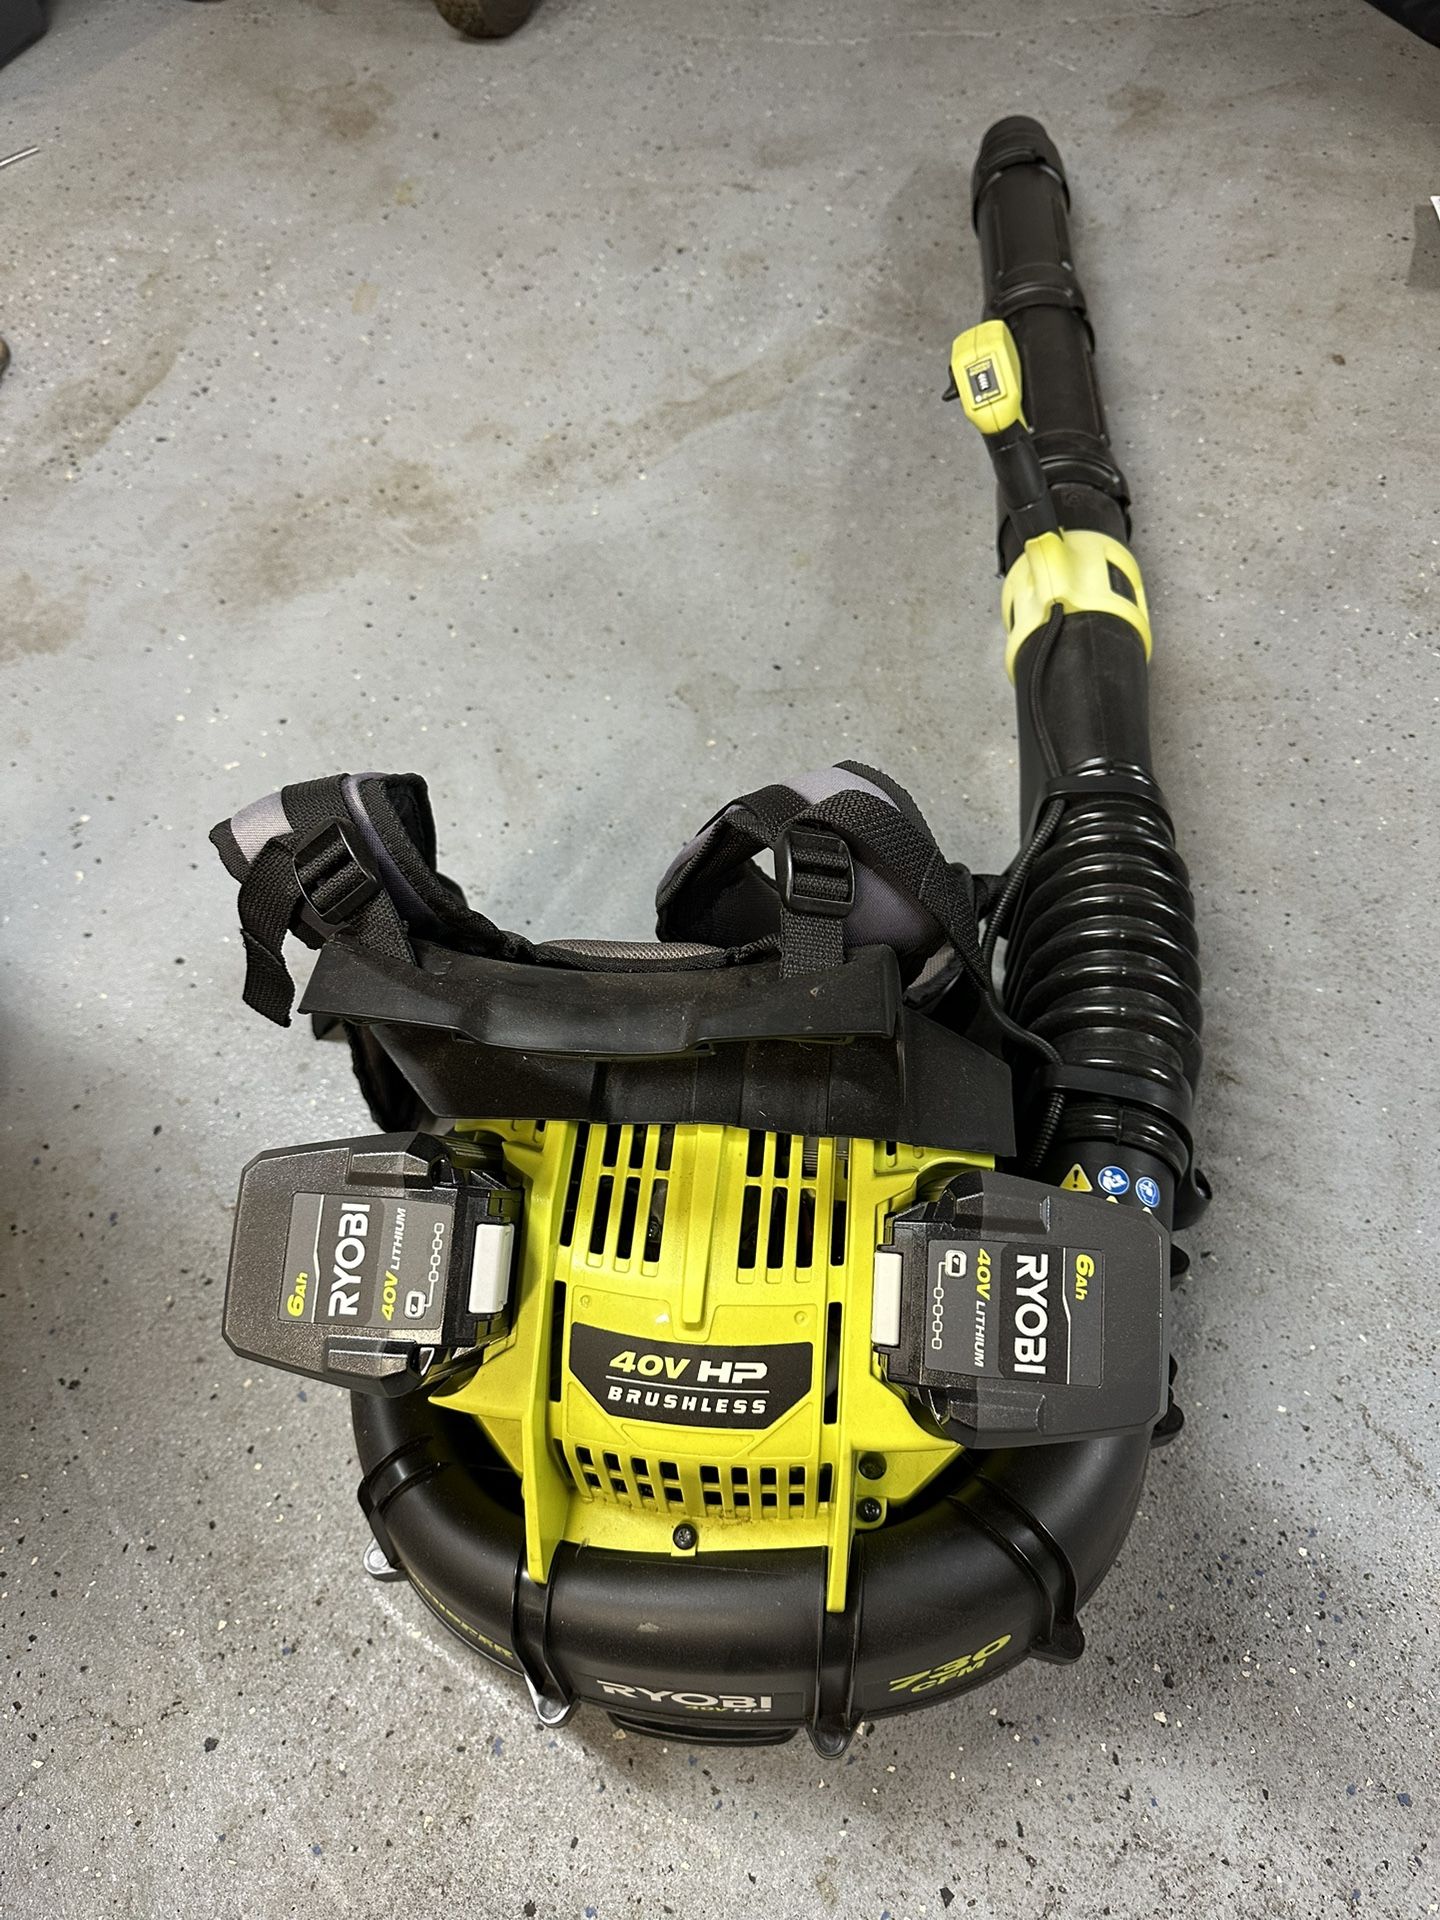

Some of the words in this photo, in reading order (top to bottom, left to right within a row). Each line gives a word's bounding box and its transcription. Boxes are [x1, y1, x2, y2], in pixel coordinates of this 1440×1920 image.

[328, 1203, 371, 1317] RYOBI
[381, 1270, 398, 1321] 40V
[391, 1207, 406, 1270] LITHIUM
[976, 1248, 992, 1301] 40V
[1075, 1254, 1095, 1301] 6Ah
[287, 1271, 309, 1317] 6Ah
[1014, 1254, 1049, 1374] RYOBI
[974, 1300, 986, 1368] LITHIUM
[609, 1350, 691, 1379] 40V
[697, 1360, 768, 1384] HP
[607, 1385, 767, 1414] BRUSHLESS
[888, 1634, 1012, 1692] 730
[911, 1658, 987, 1692] CFM
[596, 1680, 772, 1709] RYOBI
